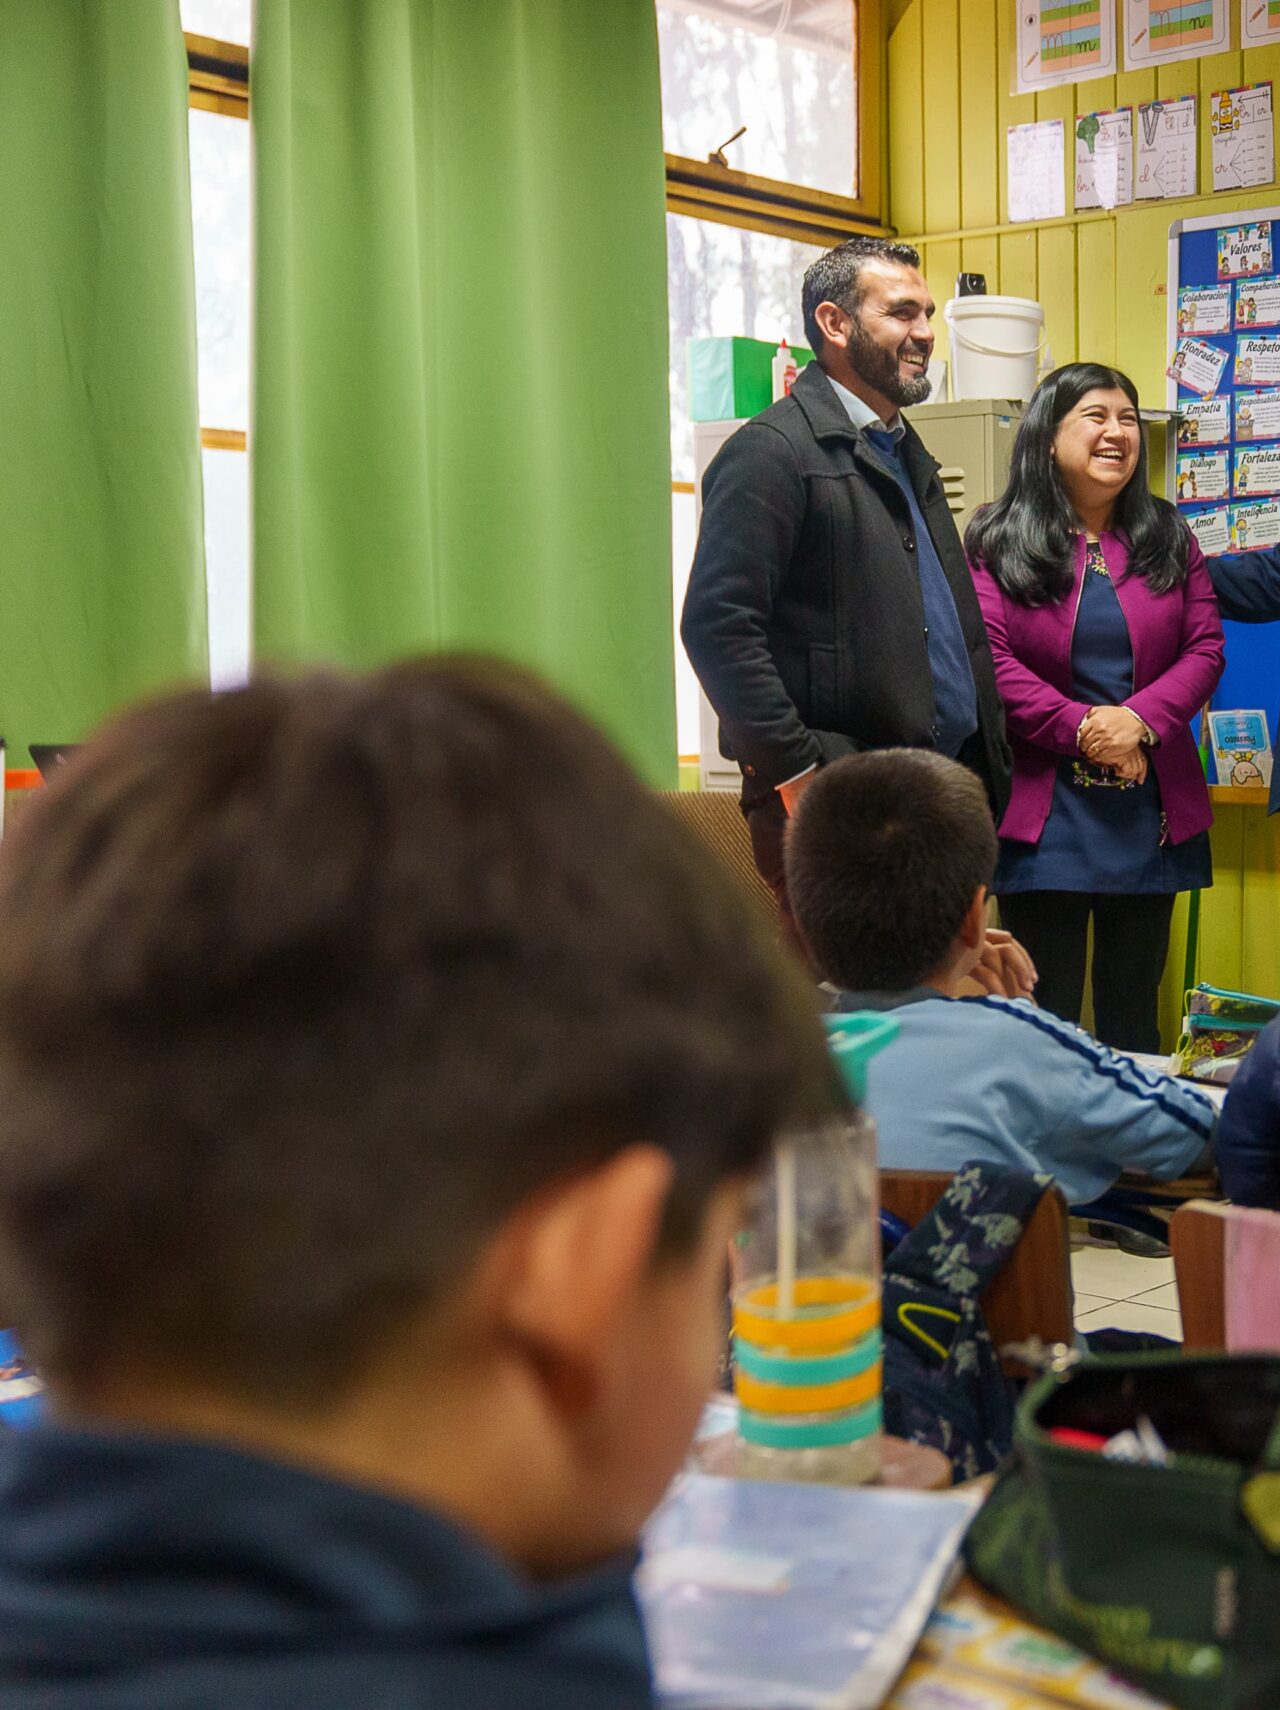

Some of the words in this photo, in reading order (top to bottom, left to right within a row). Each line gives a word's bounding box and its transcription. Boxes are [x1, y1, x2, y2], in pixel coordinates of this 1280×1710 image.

[1229, 241, 1262, 257] Valores
[1182, 290, 1229, 303] Colaboración
[1182, 340, 1221, 367] Honradez
[1246, 340, 1280, 356] Respeto
[1236, 503, 1279, 520] Inteligencia
[1192, 515, 1217, 530] Amor
